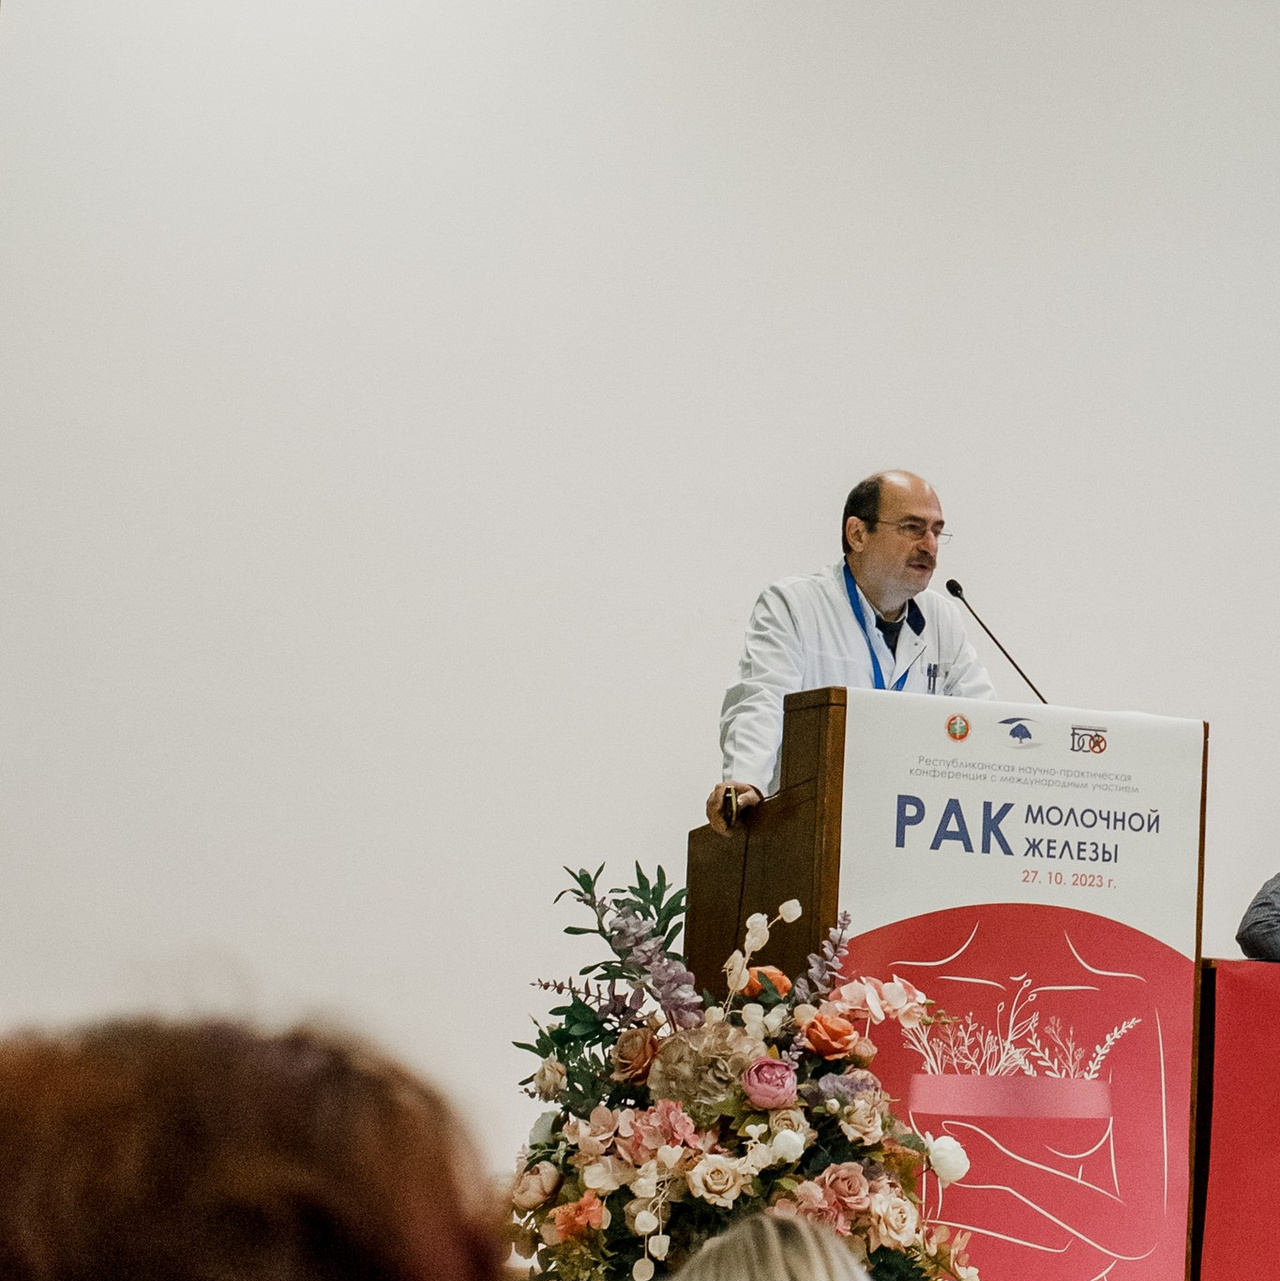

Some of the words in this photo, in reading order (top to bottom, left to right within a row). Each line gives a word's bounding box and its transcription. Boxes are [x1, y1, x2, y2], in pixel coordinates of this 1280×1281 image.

[909, 768, 987, 782] конференция
[990, 775, 997, 783] с
[1000, 776, 1089, 790] международным
[1092, 783, 1140, 794] участием
[918, 756, 1015, 772] Республиканская
[1018, 765, 1132, 782] научно-практическая
[895, 794, 1015, 856] РАК
[1024, 804, 1160, 833] МОЛОЧНОЙ
[1023, 837, 1118, 863] ЖЕЛЕЗЫ
[1022, 870, 1041, 884] 27.
[1047, 871, 1066, 885] 10.
[1072, 873, 1104, 888] 2023
[1107, 878, 1117, 888] г.
